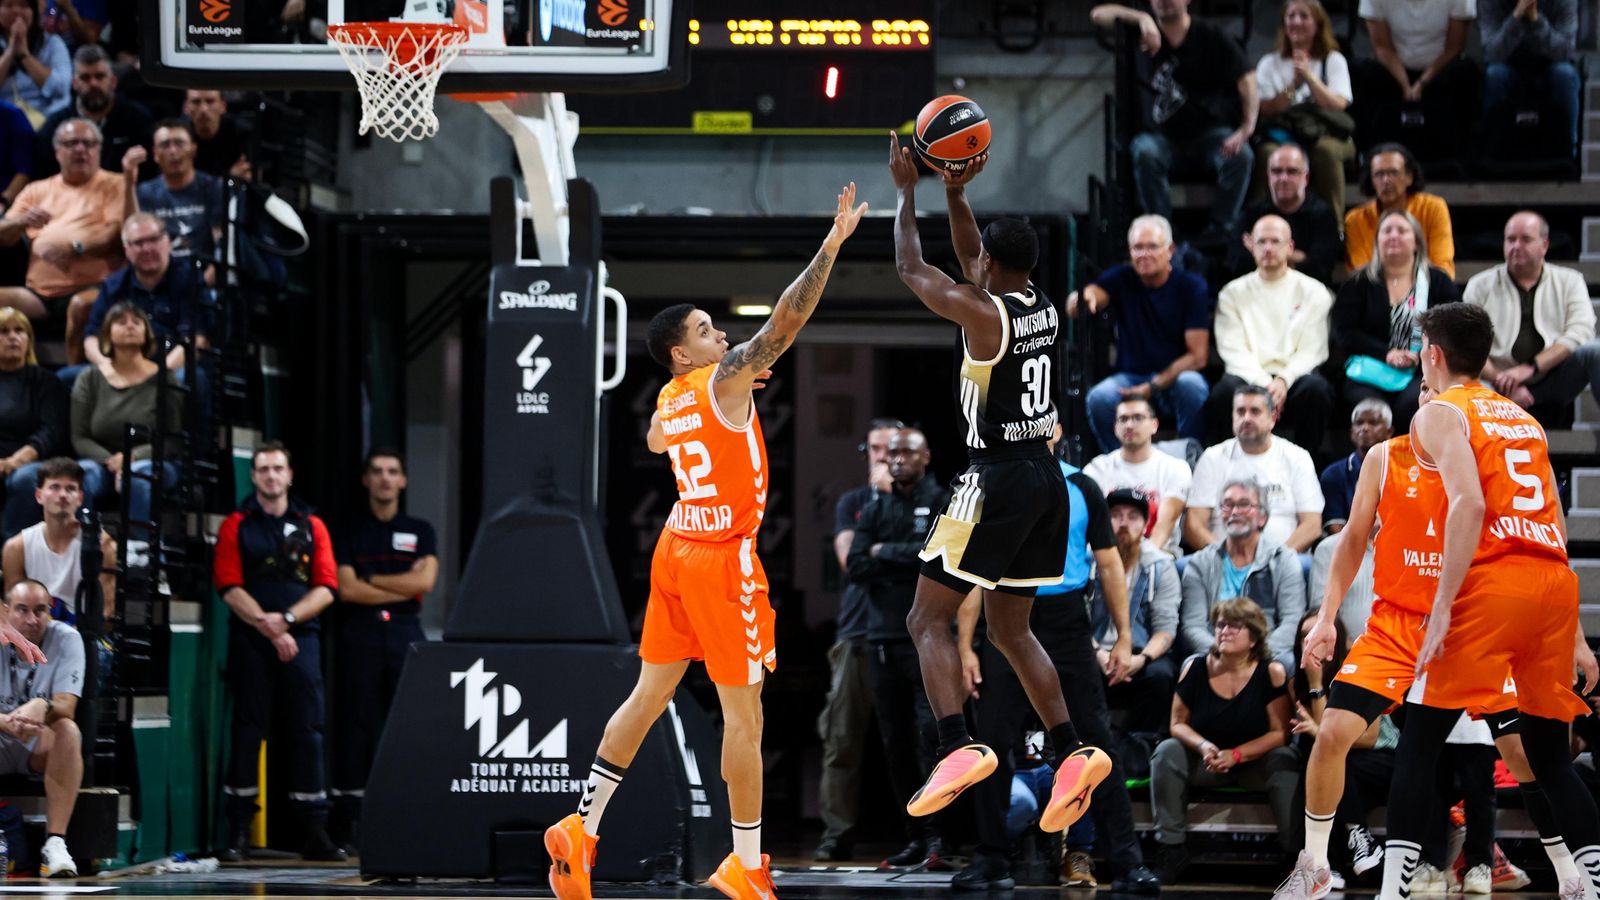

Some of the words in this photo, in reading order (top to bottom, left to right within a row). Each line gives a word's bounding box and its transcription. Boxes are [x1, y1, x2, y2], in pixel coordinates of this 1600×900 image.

[188, 25, 243, 37] EuroLeague
[586, 27, 640, 40] EuroLeague
[498, 290, 578, 312] SPALDING
[1012, 308, 1049, 339] WATSON
[1020, 353, 1051, 418] 30
[516, 392, 550, 405] LDLC
[517, 404, 550, 414] ASVEL
[660, 411, 704, 437] AMESA
[1504, 447, 1545, 512] 5
[470, 762, 508, 777] TONY
[513, 762, 570, 777] PARKER
[450, 777, 518, 793] ADÉQUAT
